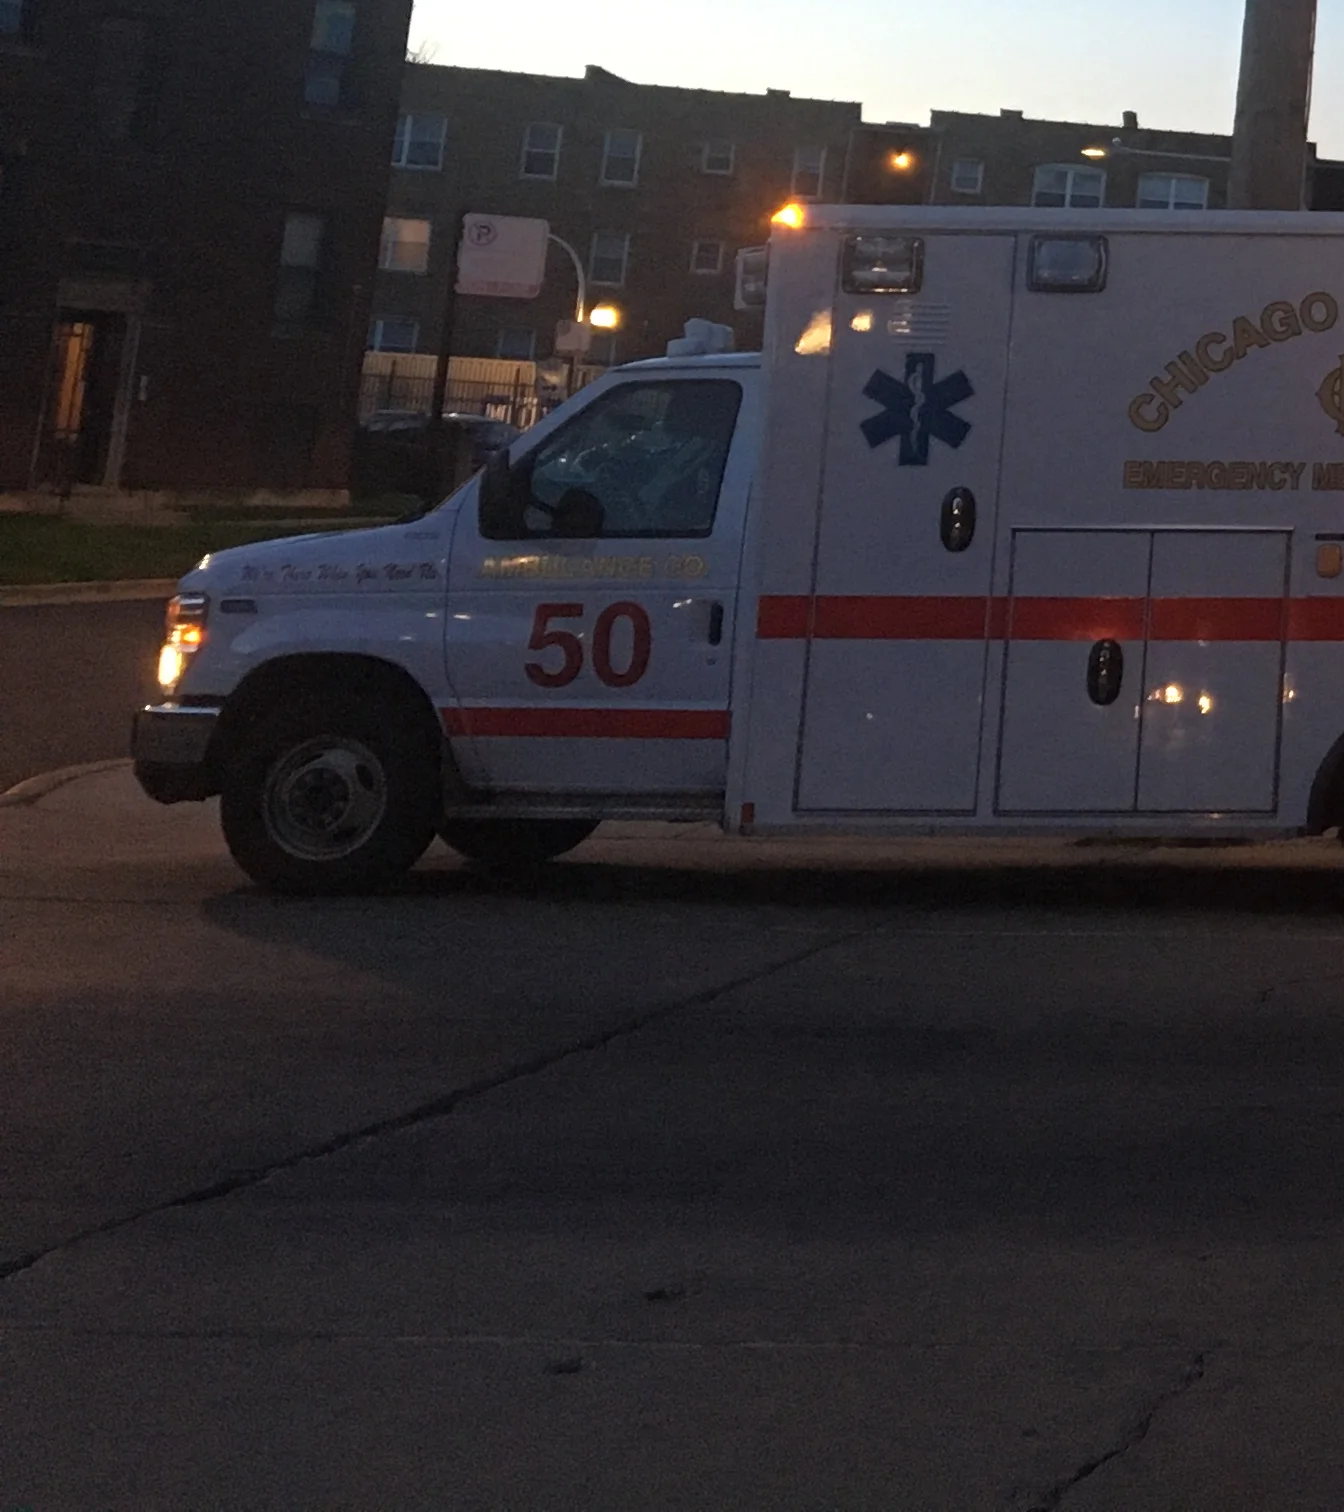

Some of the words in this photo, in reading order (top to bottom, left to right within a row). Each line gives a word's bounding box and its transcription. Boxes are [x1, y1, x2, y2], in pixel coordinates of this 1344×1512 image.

[1127, 291, 1338, 433] CHICAGO
[1123, 460, 1306, 490] EMERGENCY
[478, 554, 656, 579] AMBULANCE
[524, 601, 651, 688] 50
